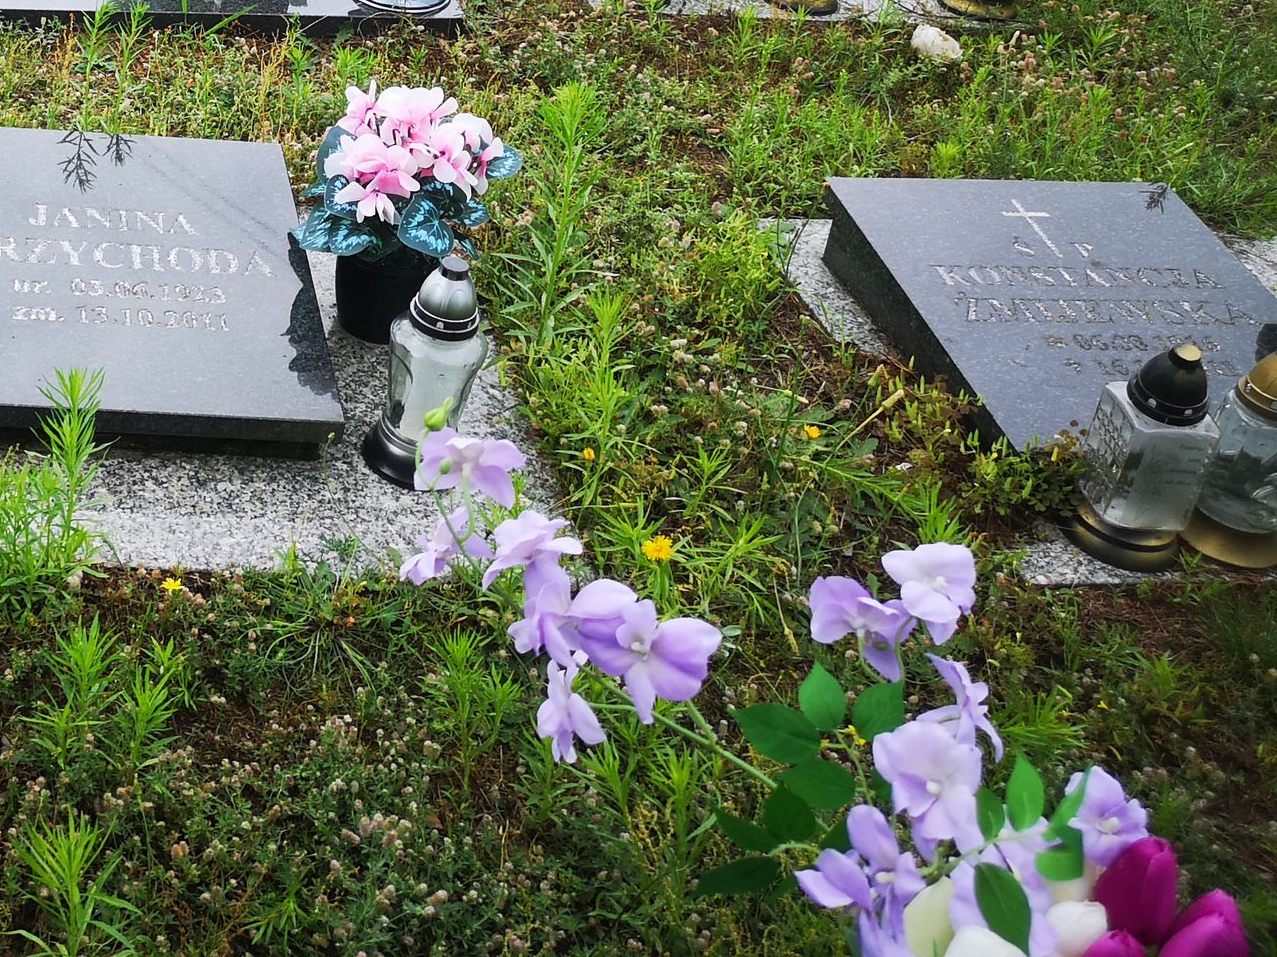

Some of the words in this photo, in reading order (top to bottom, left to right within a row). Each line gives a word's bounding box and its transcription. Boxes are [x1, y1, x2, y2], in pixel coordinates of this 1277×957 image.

[28, 203, 201, 236] JANINA
[928, 263, 1227, 290] KONSTANCJA
[953, 290, 1264, 326] ŻMIJEWSKA
